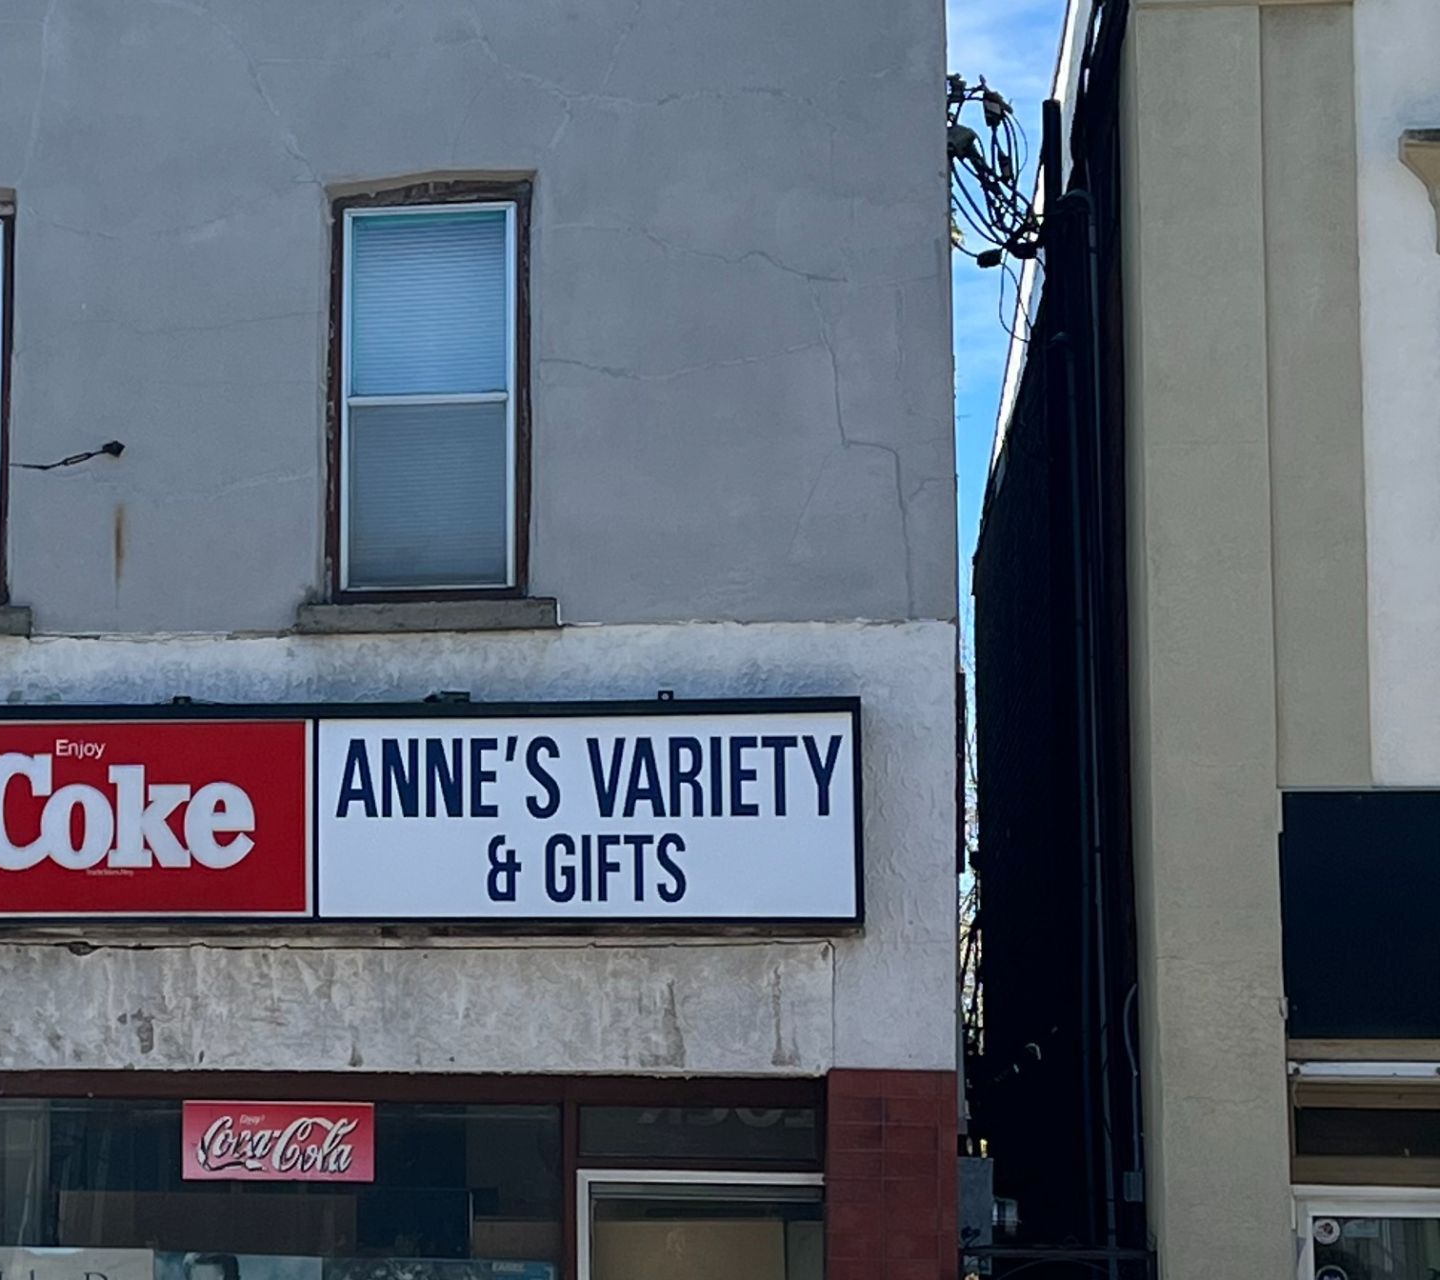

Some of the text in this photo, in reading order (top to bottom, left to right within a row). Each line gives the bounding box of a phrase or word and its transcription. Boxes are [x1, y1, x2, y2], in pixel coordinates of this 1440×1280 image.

[55, 738, 106, 760] Enjoy
[335, 732, 844, 820] ANNE'S VARIETY
[486, 833, 689, 904] & GIFTS
[196, 1115, 358, 1172] Coca-Cola
